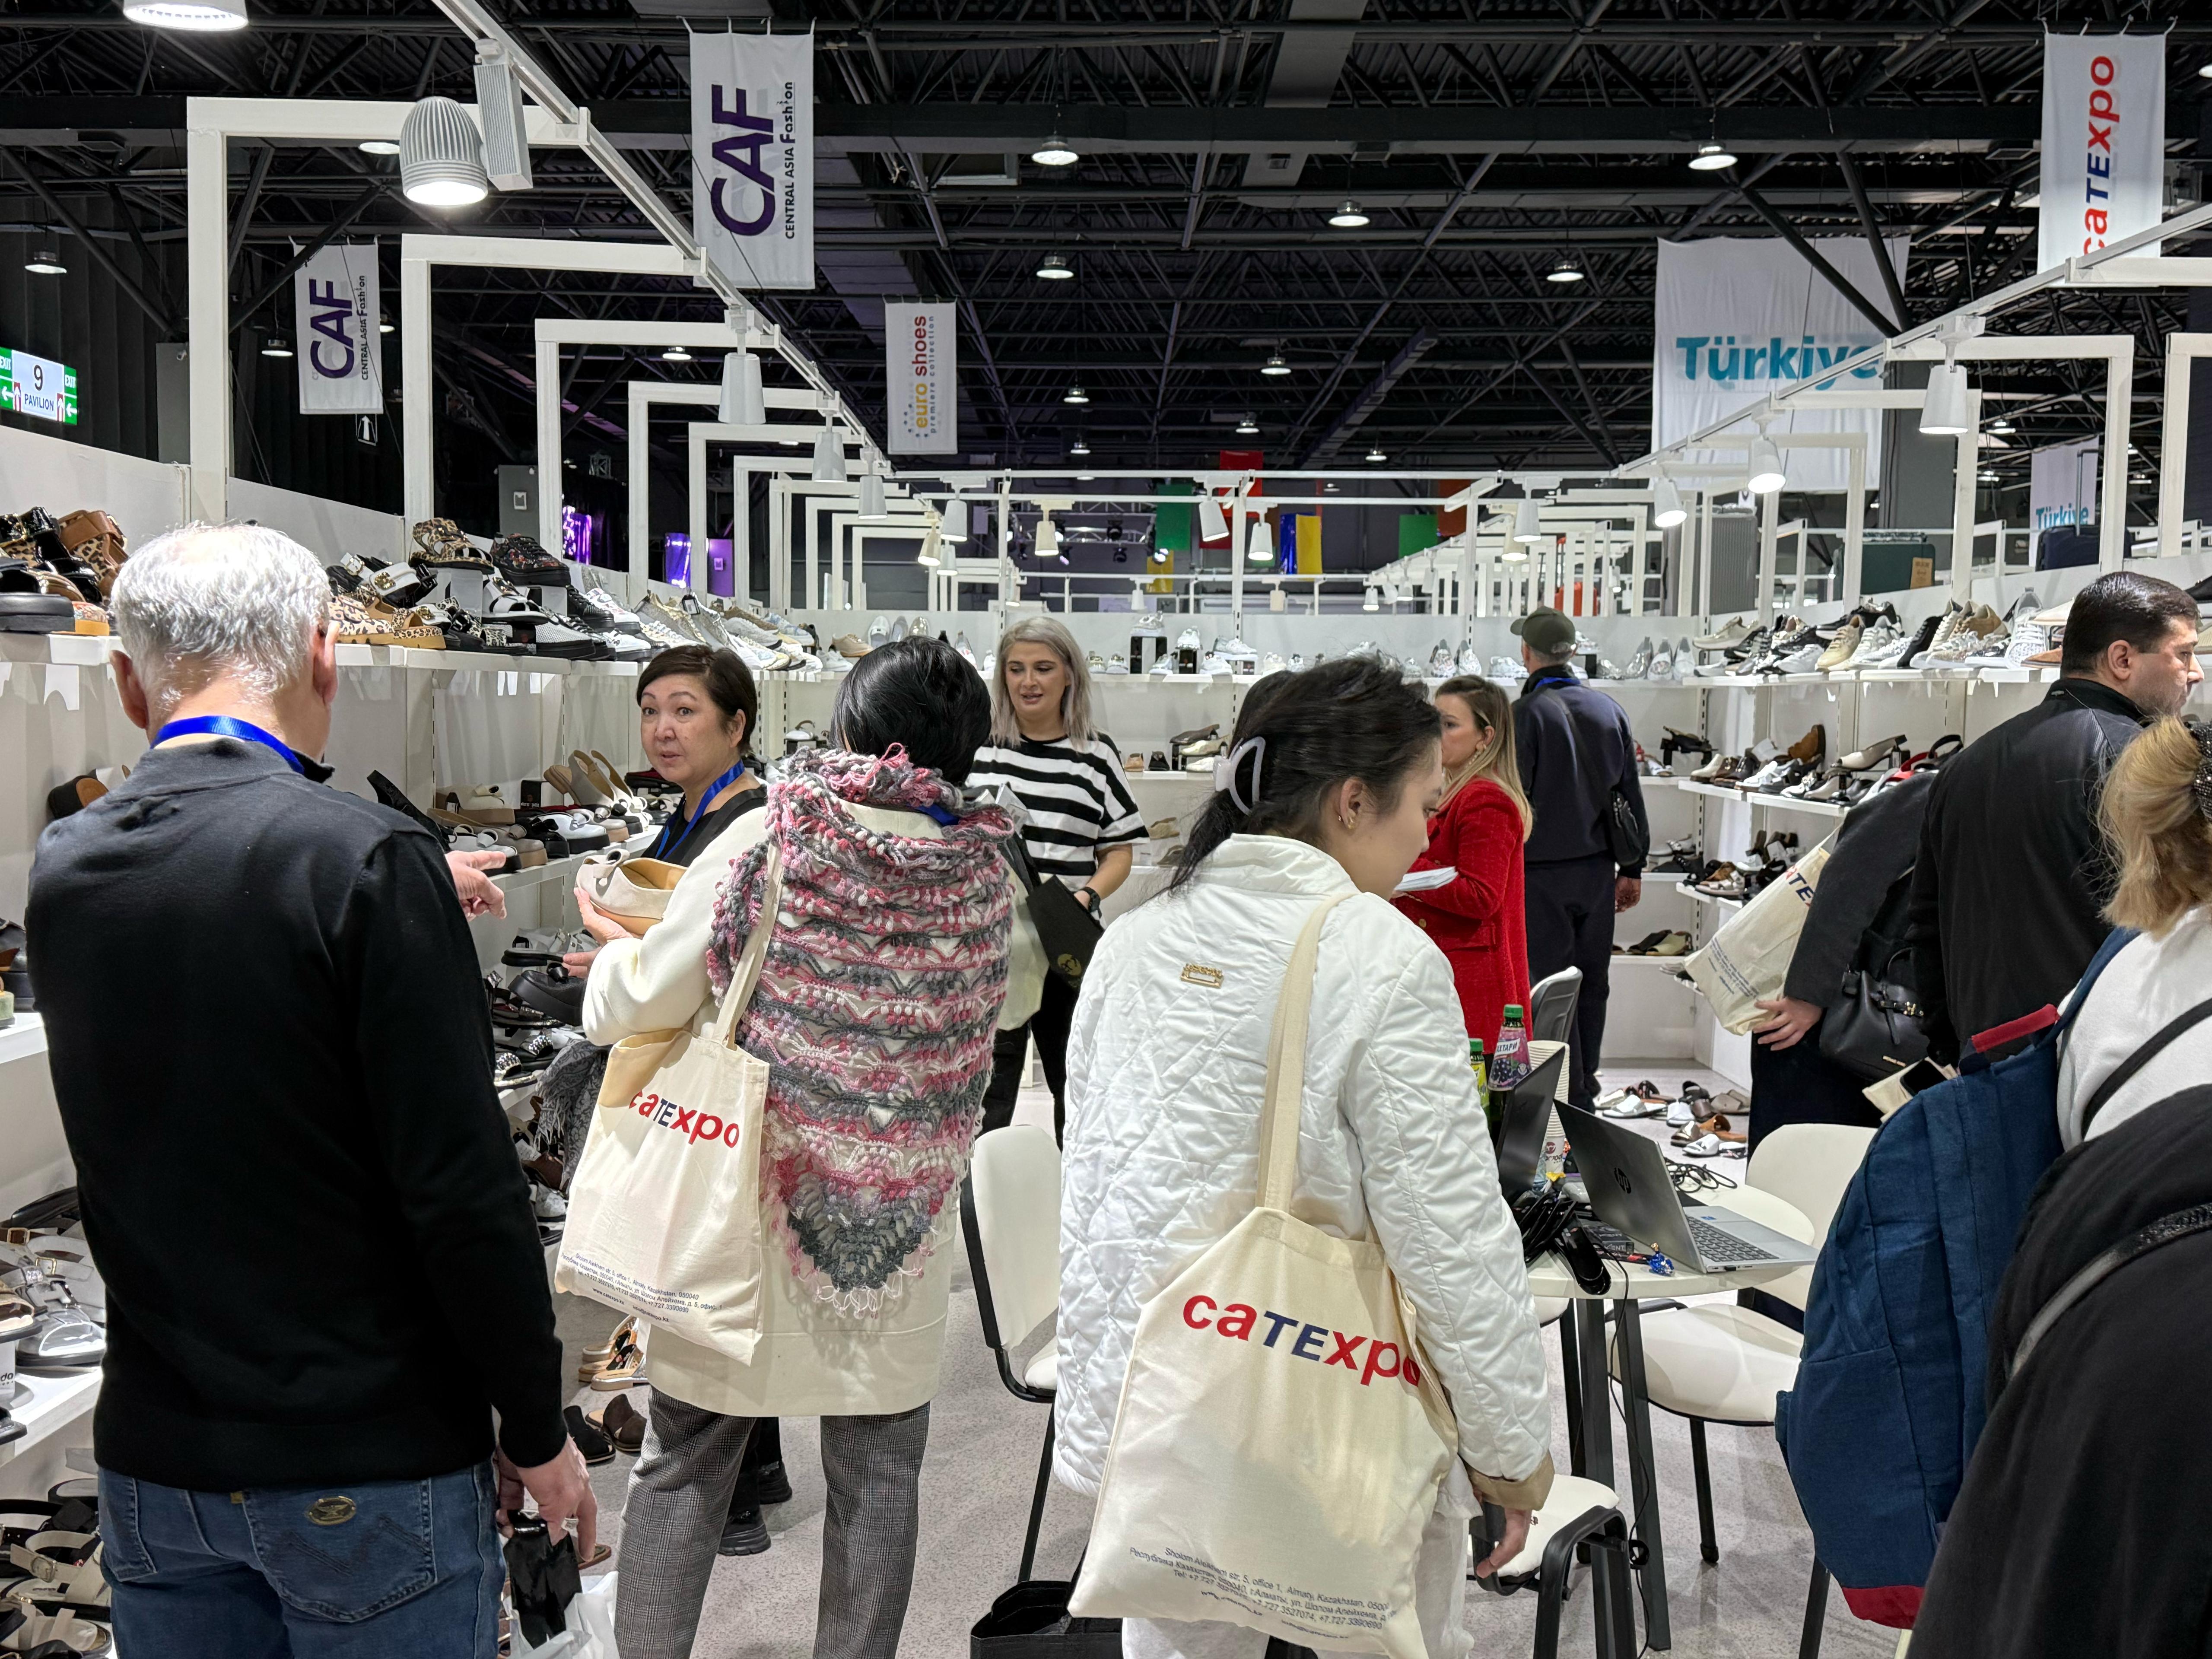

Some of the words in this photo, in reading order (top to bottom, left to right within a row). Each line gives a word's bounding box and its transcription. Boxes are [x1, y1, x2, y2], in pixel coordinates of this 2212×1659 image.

[710, 84, 775, 236] CAF
[785, 148, 795, 178] ASIA
[785, 182, 795, 239] CENTRAL
[309, 279, 354, 378] CAF
[912, 315, 927, 376] shoes
[0, 356, 11, 371] EXIT
[34, 365, 43, 391] 9
[65, 375, 76, 388] EXIT
[25, 394, 54, 411] PAVILION
[915, 382, 928, 428] euro
[1614, 1167, 1631, 1194] hp
[678, 1292, 699, 1300] 050040
